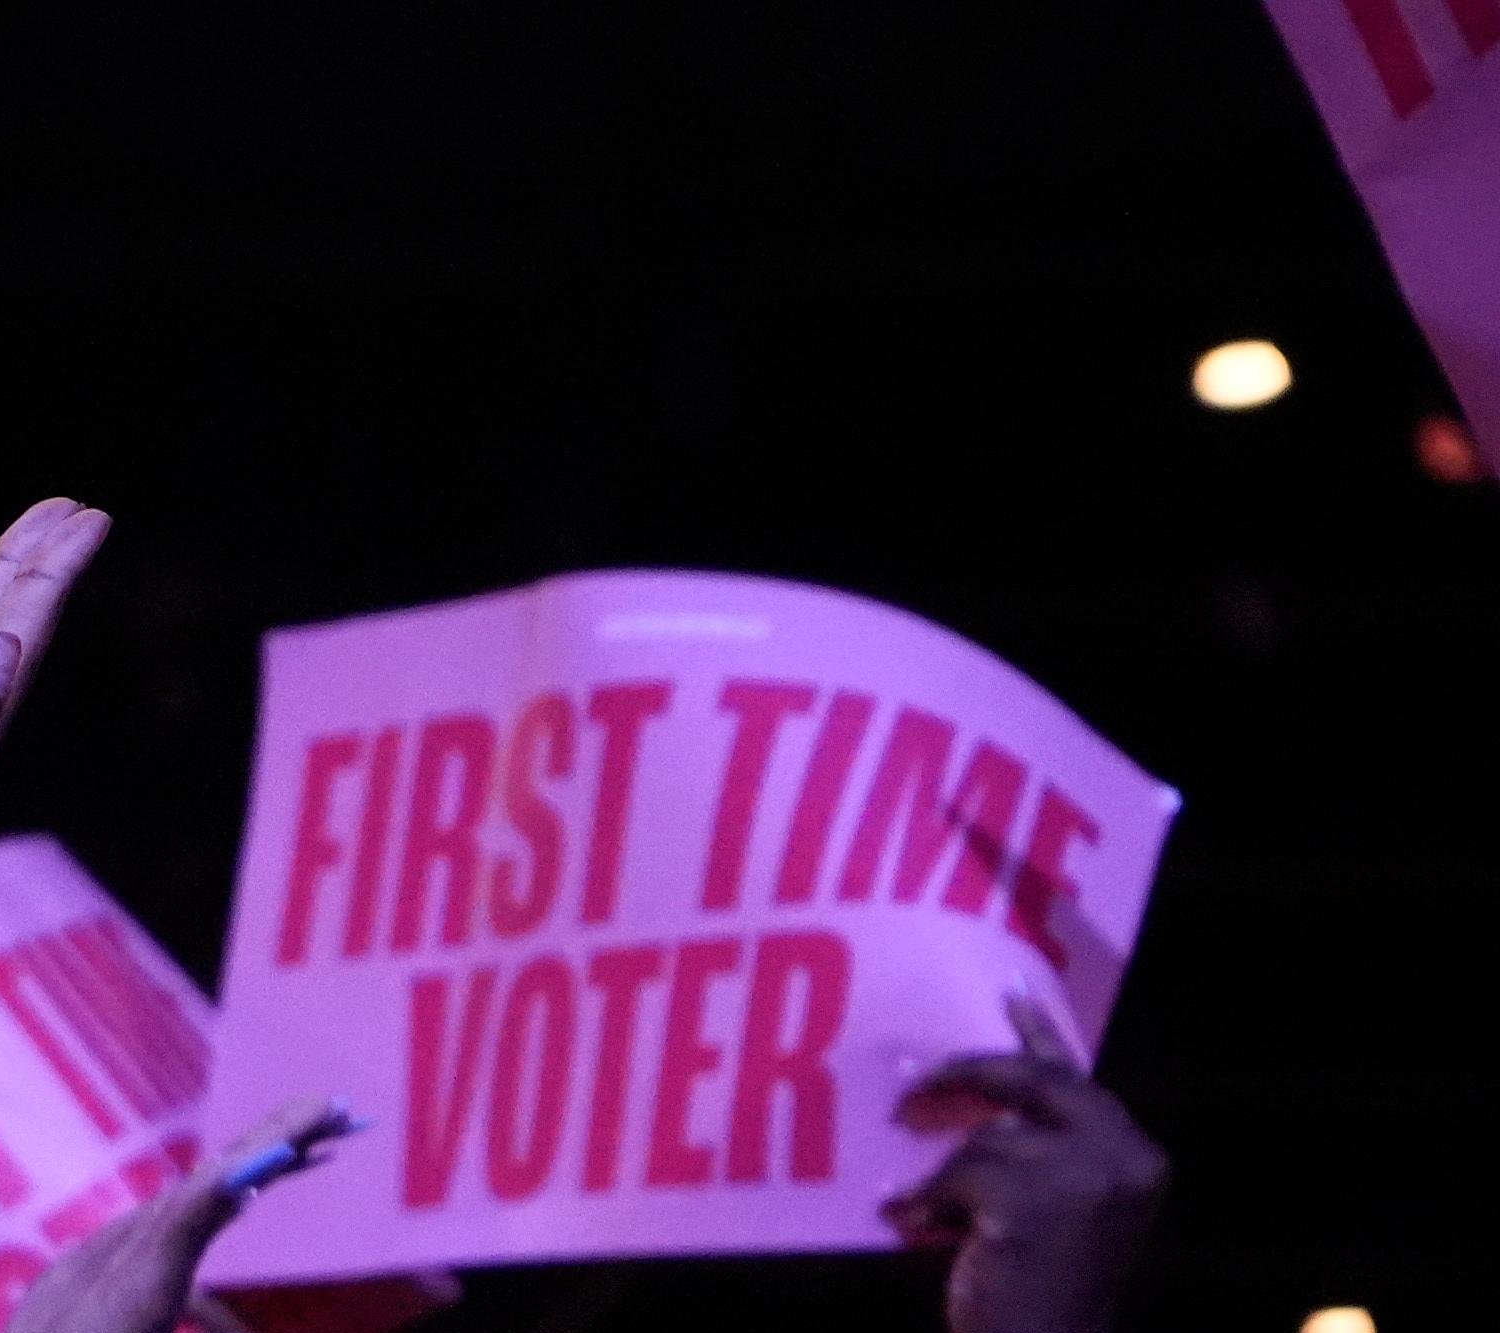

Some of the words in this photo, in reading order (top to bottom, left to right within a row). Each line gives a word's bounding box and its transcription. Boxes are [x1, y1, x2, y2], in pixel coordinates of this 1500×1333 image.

[275, 676, 674, 972] FIRST
[699, 674, 1104, 976] TIME
[399, 926, 856, 1213] VOTER
